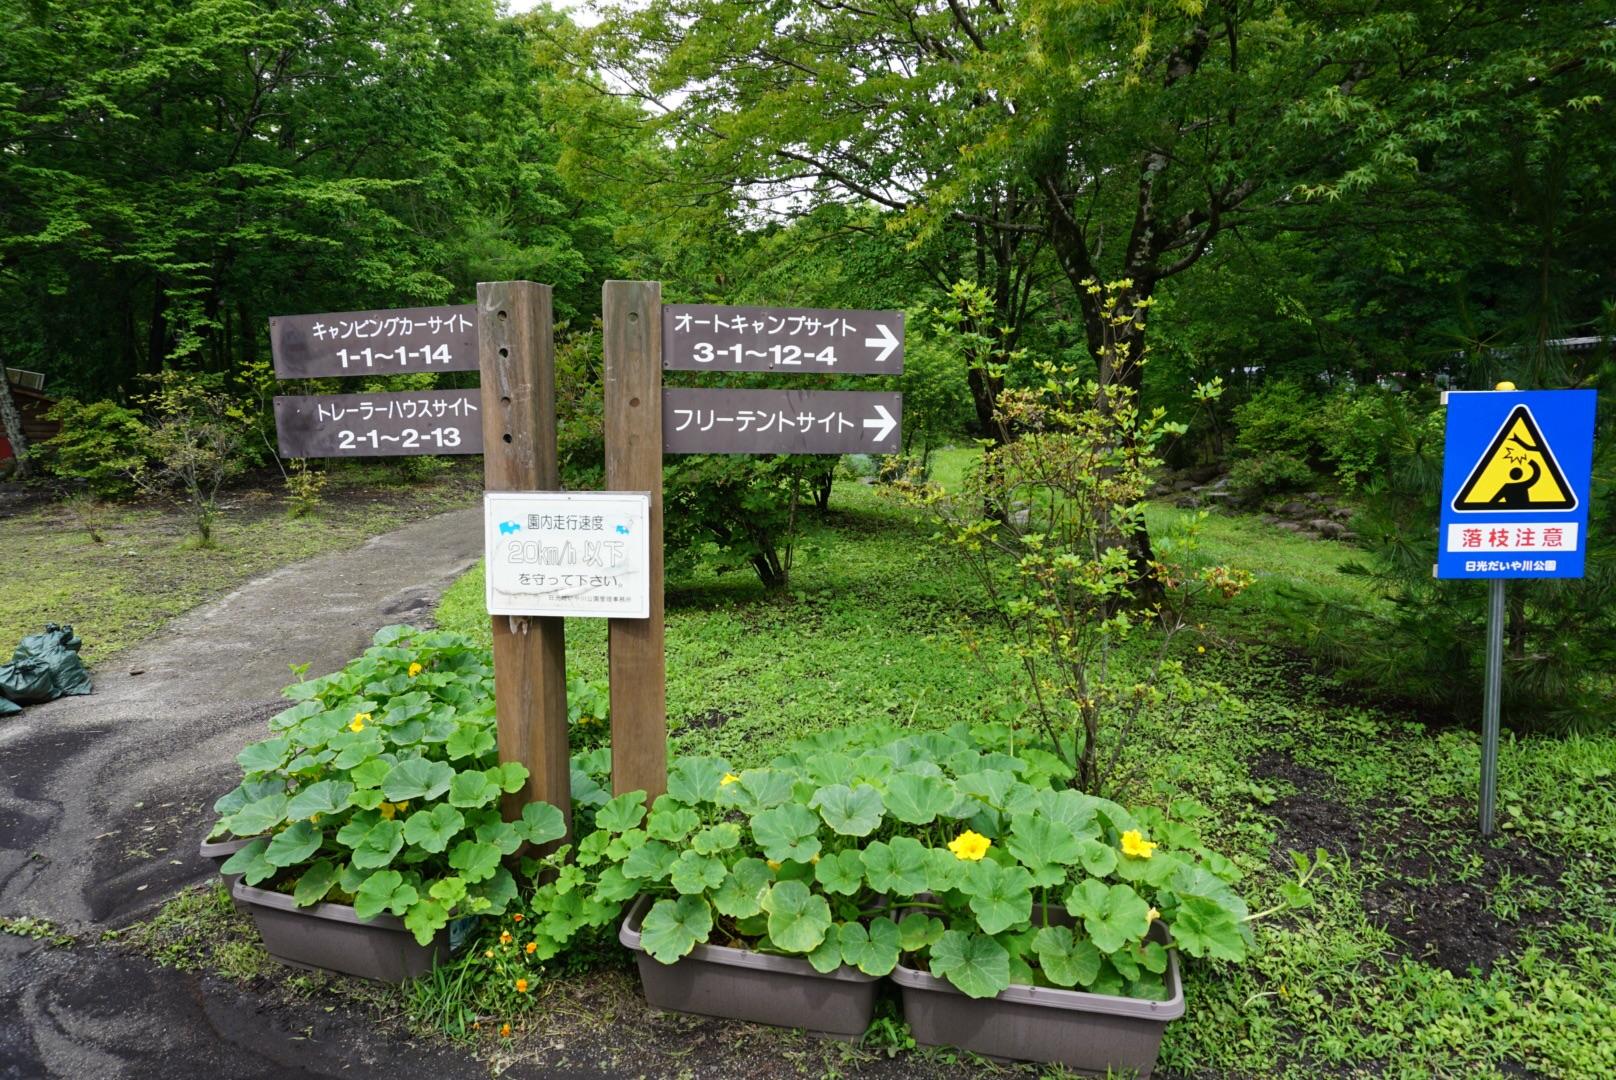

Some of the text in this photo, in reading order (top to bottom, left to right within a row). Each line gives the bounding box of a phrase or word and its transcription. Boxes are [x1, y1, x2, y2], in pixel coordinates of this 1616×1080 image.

[674, 313, 857, 337] オートキャンプサイト
[318, 398, 478, 422] トレーラーハウスサイト
[673, 409, 855, 434] フリーテントサイト
[527, 513, 605, 531] 園内走行速度
[1462, 528, 1563, 548] 落枝注意
[507, 540, 624, 568] 20km/h 以下
[1465, 560, 1557, 572] 日光だいや川公園
[519, 573, 624, 588] を守って下さい。
